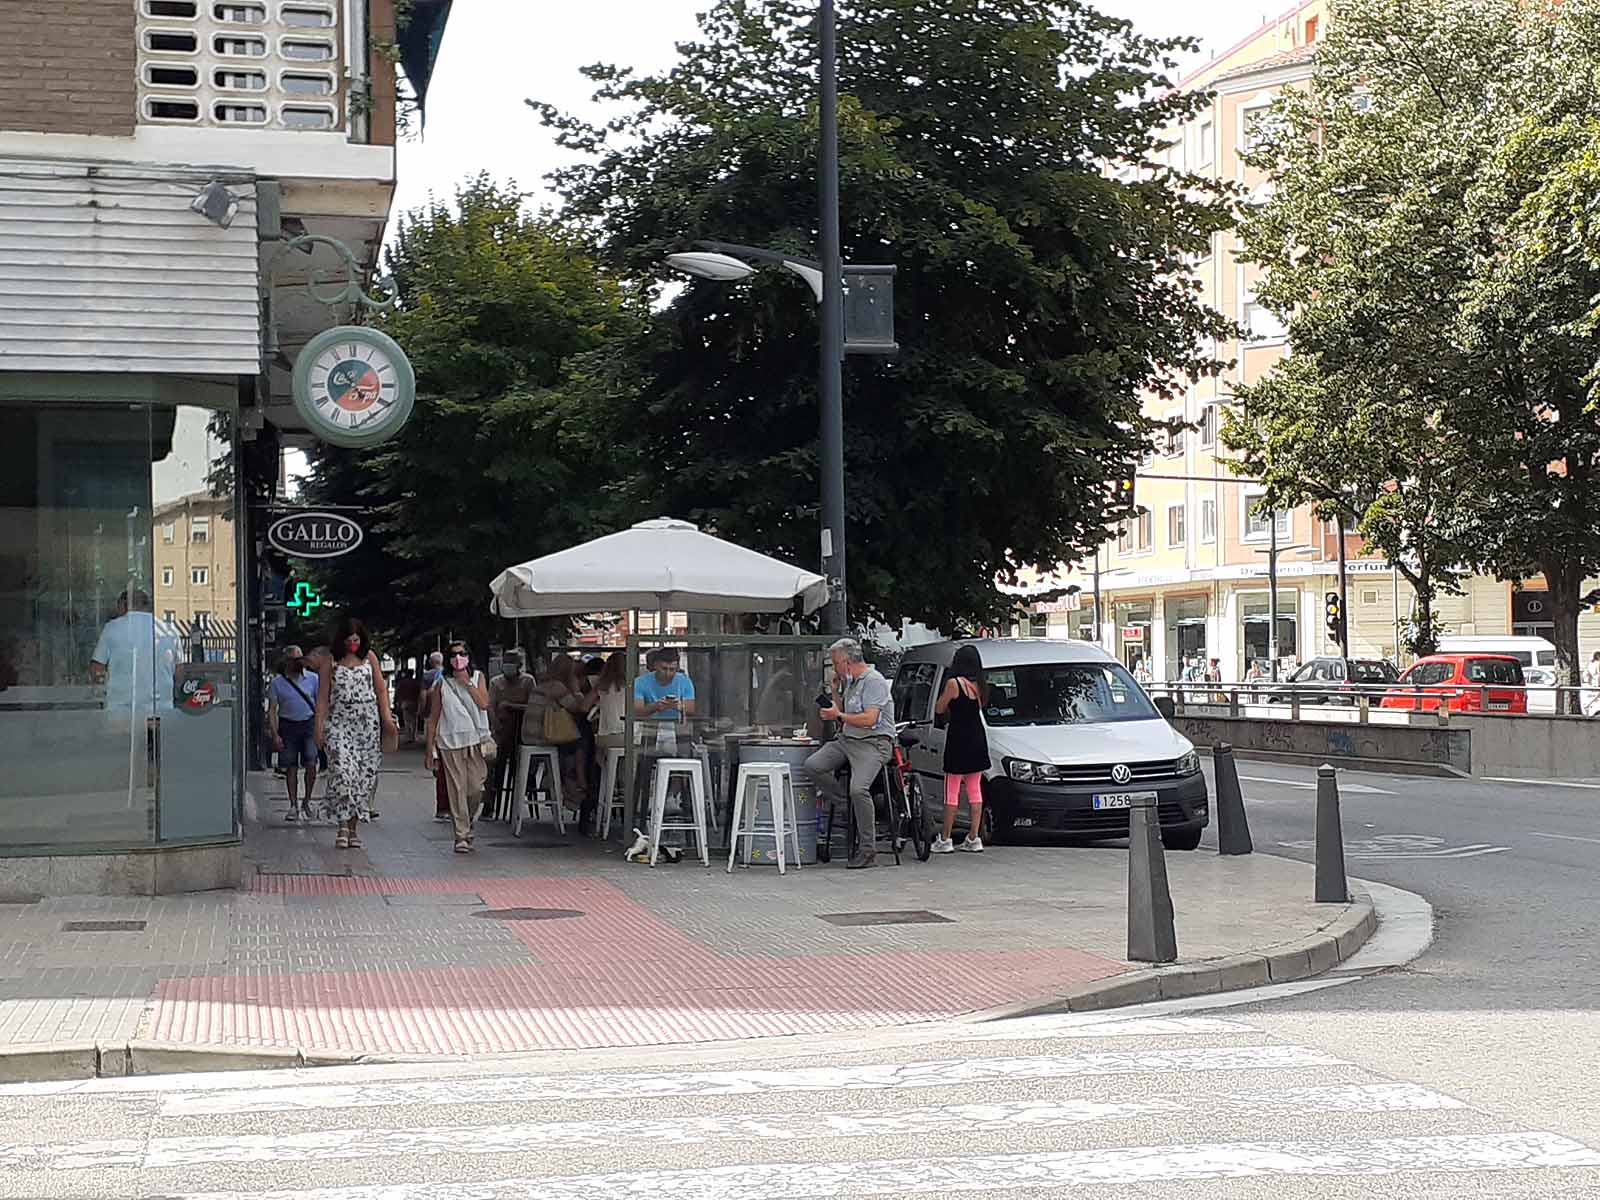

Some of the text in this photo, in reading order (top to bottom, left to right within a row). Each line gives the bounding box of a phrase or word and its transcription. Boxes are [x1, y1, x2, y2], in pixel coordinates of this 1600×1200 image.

[277, 523, 354, 541] GALLO
[310, 541, 348, 549] REGALOS
[1103, 795, 1131, 807] 1258
